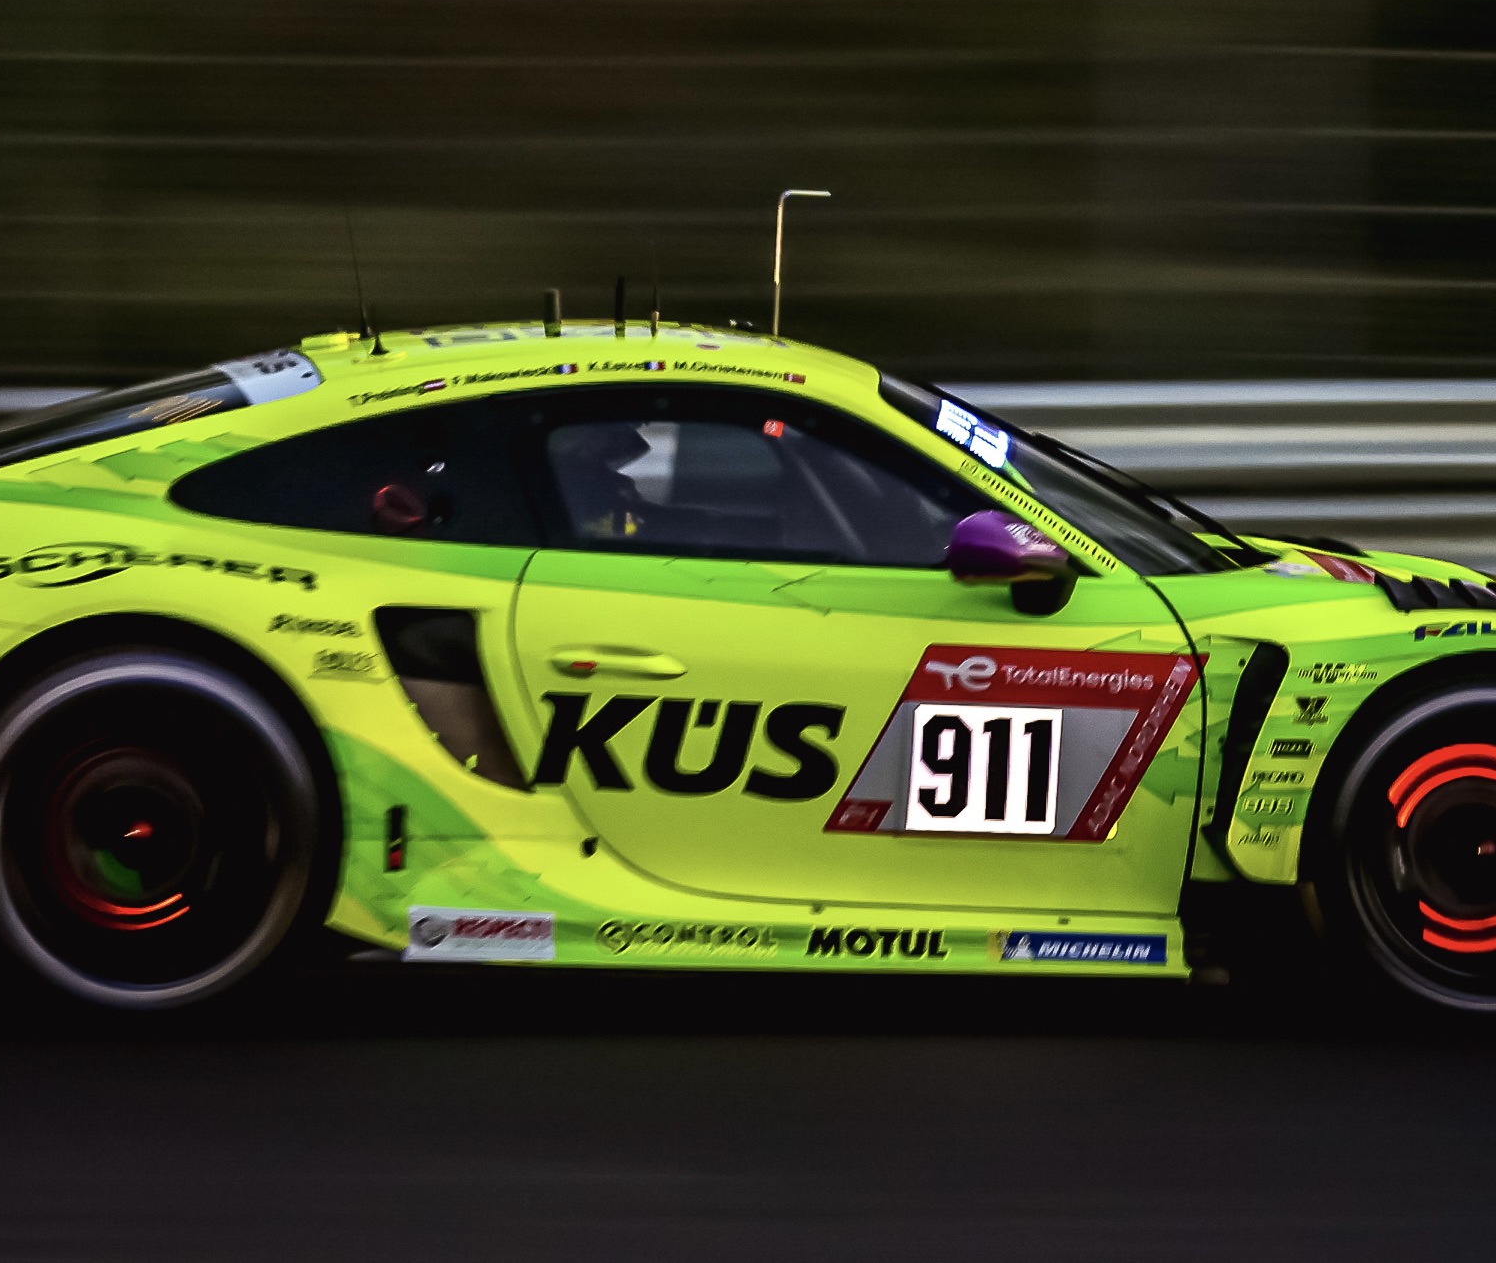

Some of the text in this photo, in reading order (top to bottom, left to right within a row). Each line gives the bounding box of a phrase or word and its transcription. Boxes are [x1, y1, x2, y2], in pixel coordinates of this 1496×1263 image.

[1002, 664, 1154, 694] TotalEnergies
[530, 690, 848, 803] KÜS
[917, 713, 1054, 823] 911
[805, 927, 950, 959] MOTUL
[1036, 939, 1152, 961] MICHELIN
